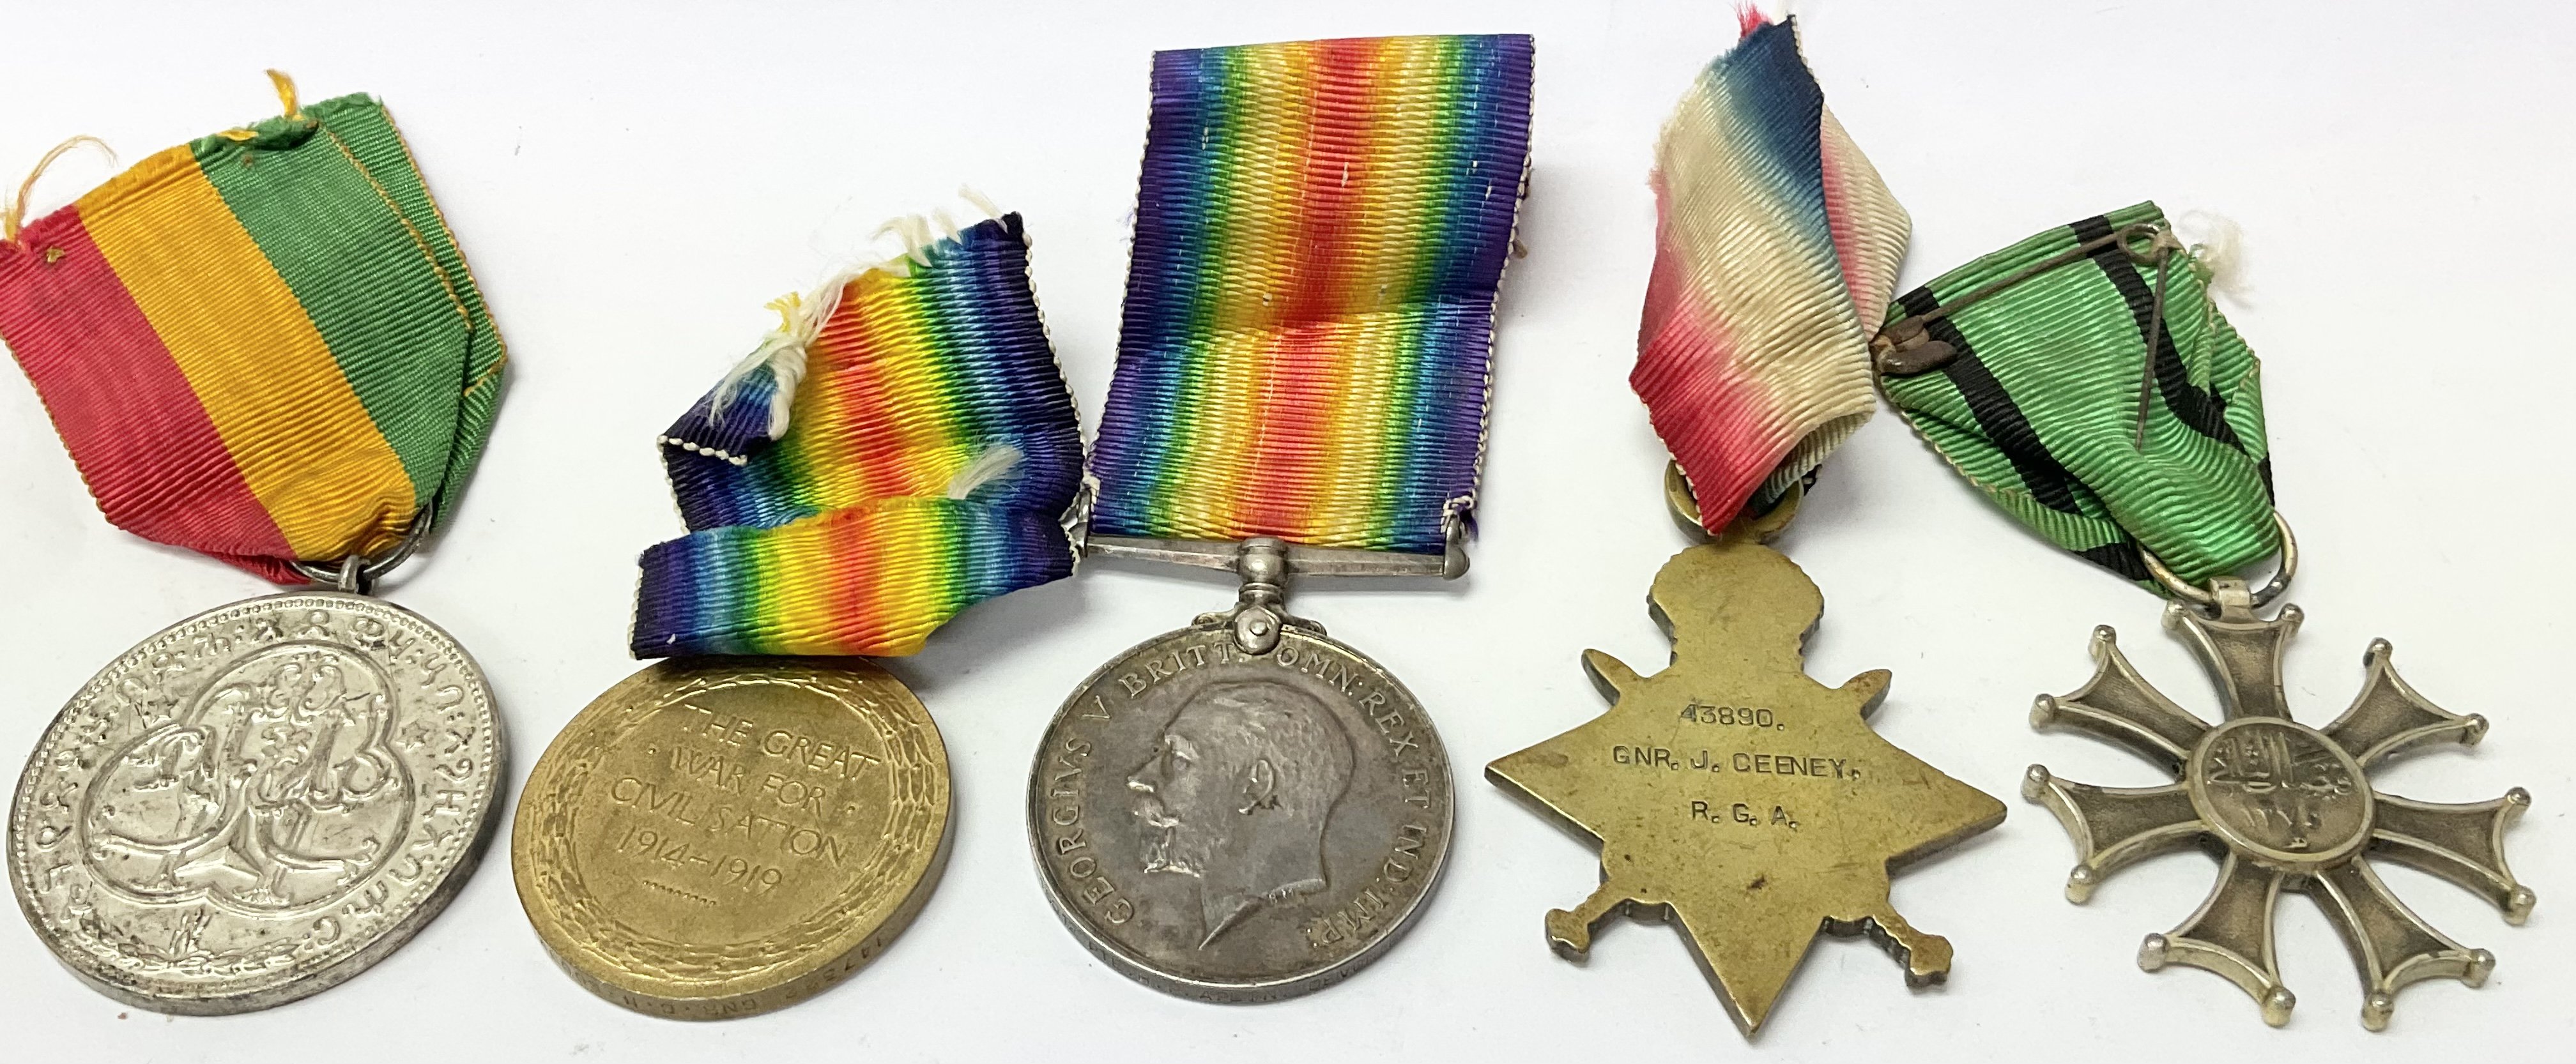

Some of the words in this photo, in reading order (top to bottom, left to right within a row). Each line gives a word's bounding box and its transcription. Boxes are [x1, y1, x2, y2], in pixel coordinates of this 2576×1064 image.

[1082, 695, 1110, 720] V
[1359, 692, 1419, 757] REX
[684, 704, 755, 747] THE
[763, 729, 882, 782] GREAT
[1613, 744, 1679, 771] GNR.
[1690, 750, 1720, 773] J.
[671, 745, 743, 797] WAR
[760, 773, 827, 818] FOR
[1402, 768, 1431, 809] ET
[1051, 737, 1134, 925] GEORGIVS
[1690, 800, 1721, 824] R.
[1732, 803, 1758, 826] G.
[1771, 805, 1798, 829] A.
[616, 825, 783, 894] 1914-1919
